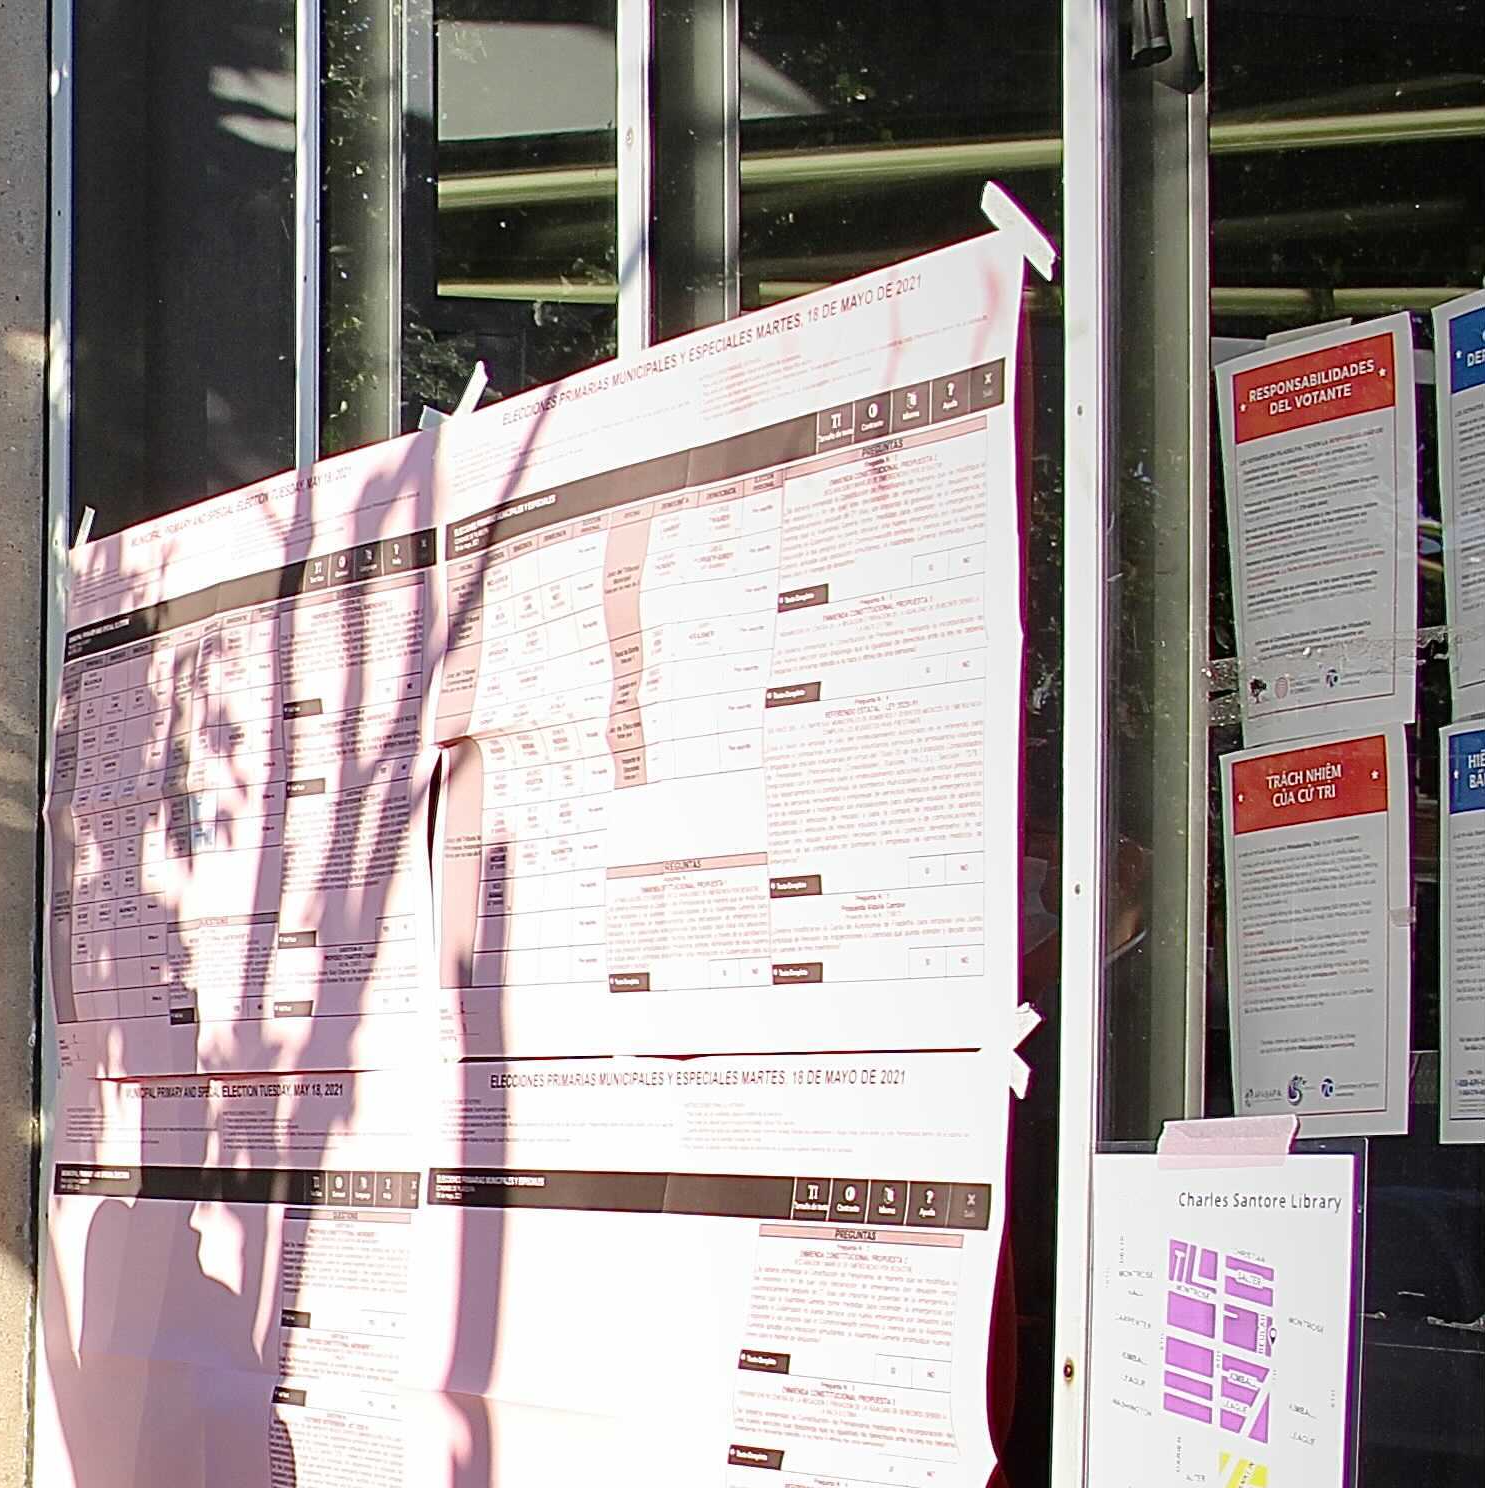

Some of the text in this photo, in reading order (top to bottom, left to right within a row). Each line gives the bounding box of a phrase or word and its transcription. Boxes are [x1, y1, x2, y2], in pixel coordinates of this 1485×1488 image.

[612, 353, 678, 387] MUNICIPALES
[689, 328, 753, 362] ESPECIALES
[756, 312, 804, 340] MARTES,
[807, 306, 819, 324] 18
[822, 301, 837, 319] DE
[840, 289, 874, 313] MAYO
[877, 281, 893, 302] DE
[895, 273, 923, 296] 2021
[1467, 349, 1485, 368] DE
[1249, 359, 1375, 403] RESPONSABILIDADES
[1269, 383, 1353, 417] DEL VOTANTE
[1266, 770, 1304, 790] TRÁCH
[1316, 783, 1336, 800] TRI
[490, 1073, 544, 1089] ELECCIONES
[546, 1072, 597, 1088] PRIMARIAS
[598, 1071, 665, 1087] MUNICIPALES
[666, 1071, 673, 1085] Y
[676, 1070, 739, 1086] ESPECIALES
[807, 1069, 822, 1085] DE
[824, 1069, 858, 1085] MAYO
[860, 1069, 877, 1085] DE
[880, 1069, 906, 1085] 2021
[157, 1086, 181, 1099] PRIMARY
[183, 1086, 196, 1098] AND
[222, 1084, 258, 1098] ELECTION
[293, 1083, 310, 1097] MAY
[324, 1083, 344, 1097] 2021
[1178, 1191, 1342, 1213] Charles Santore Library
[834, 1229, 877, 1242] PREGUNTAS
